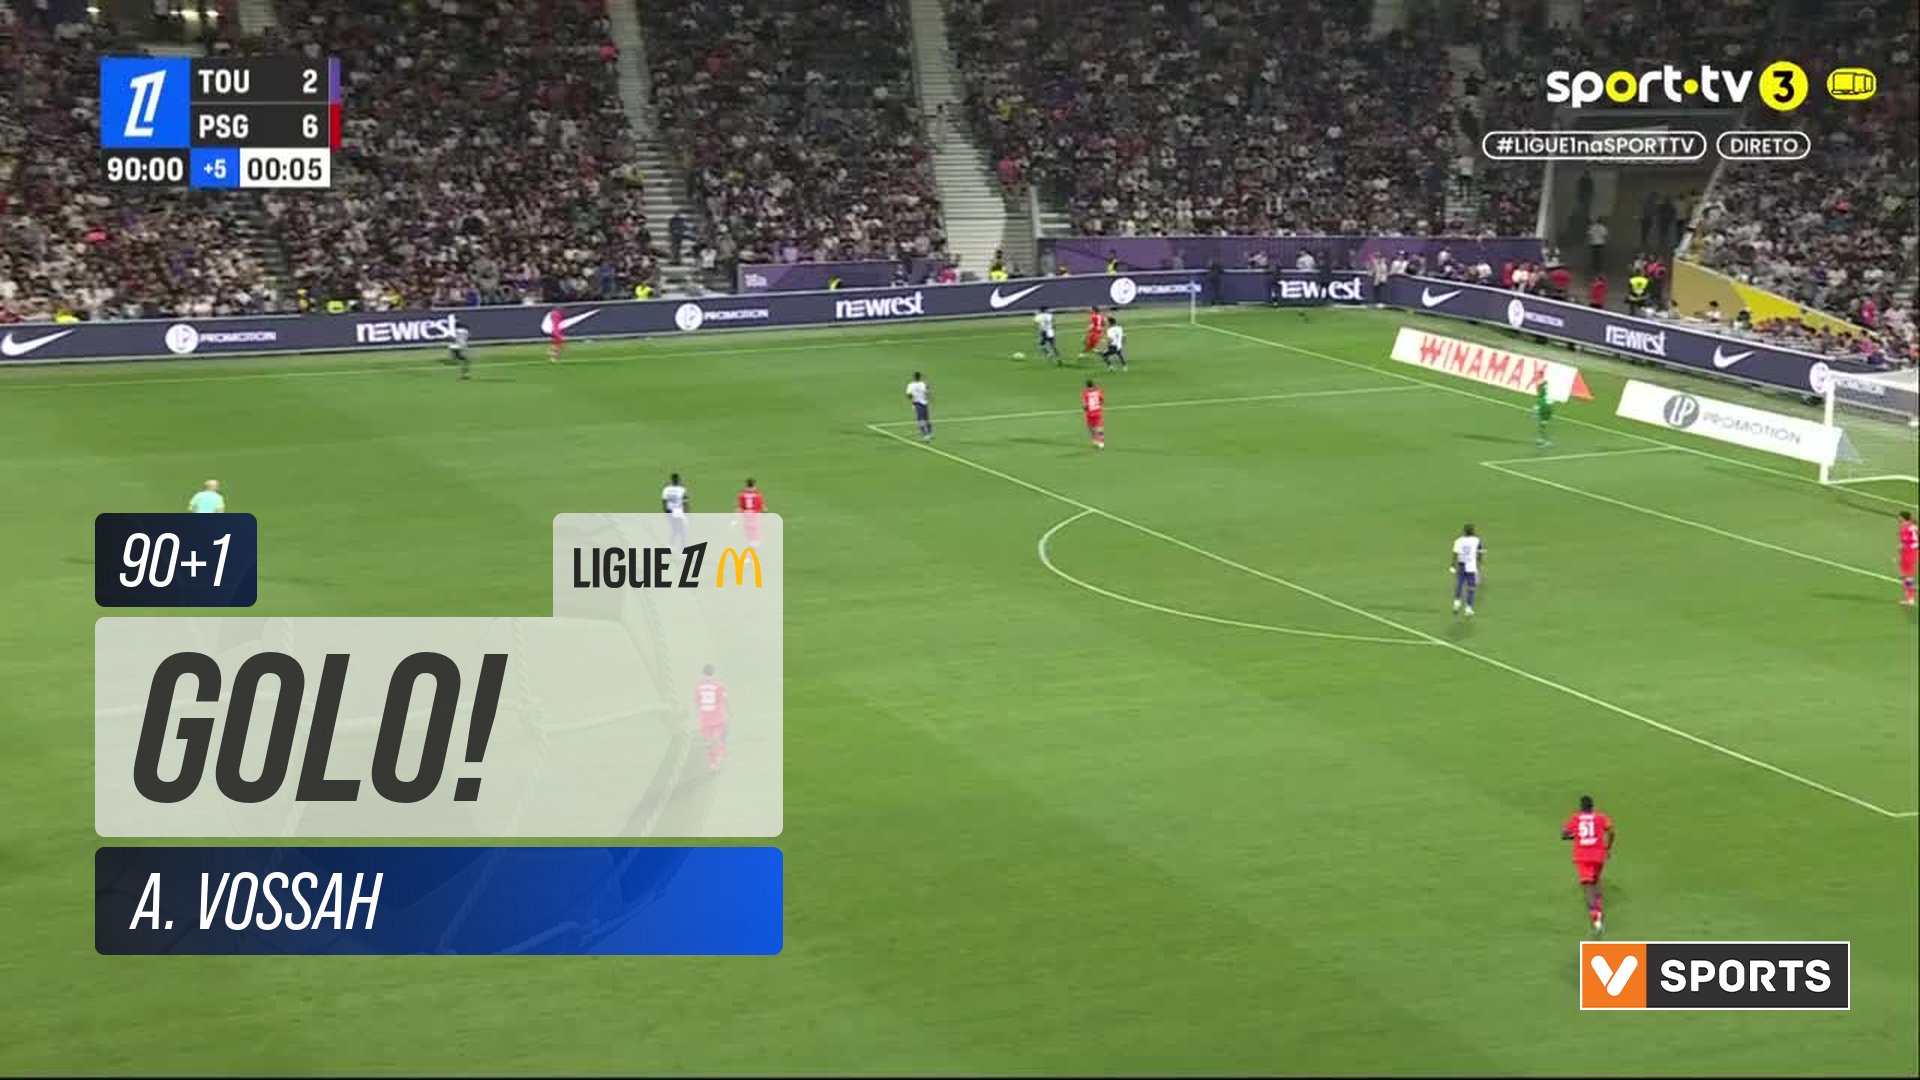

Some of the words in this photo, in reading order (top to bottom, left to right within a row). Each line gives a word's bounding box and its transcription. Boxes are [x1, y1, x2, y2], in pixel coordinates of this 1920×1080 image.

[1419, 335, 1549, 392] WINAMAX
[1701, 411, 1802, 445] PROMOTION
[1578, 820, 1595, 838] 51
